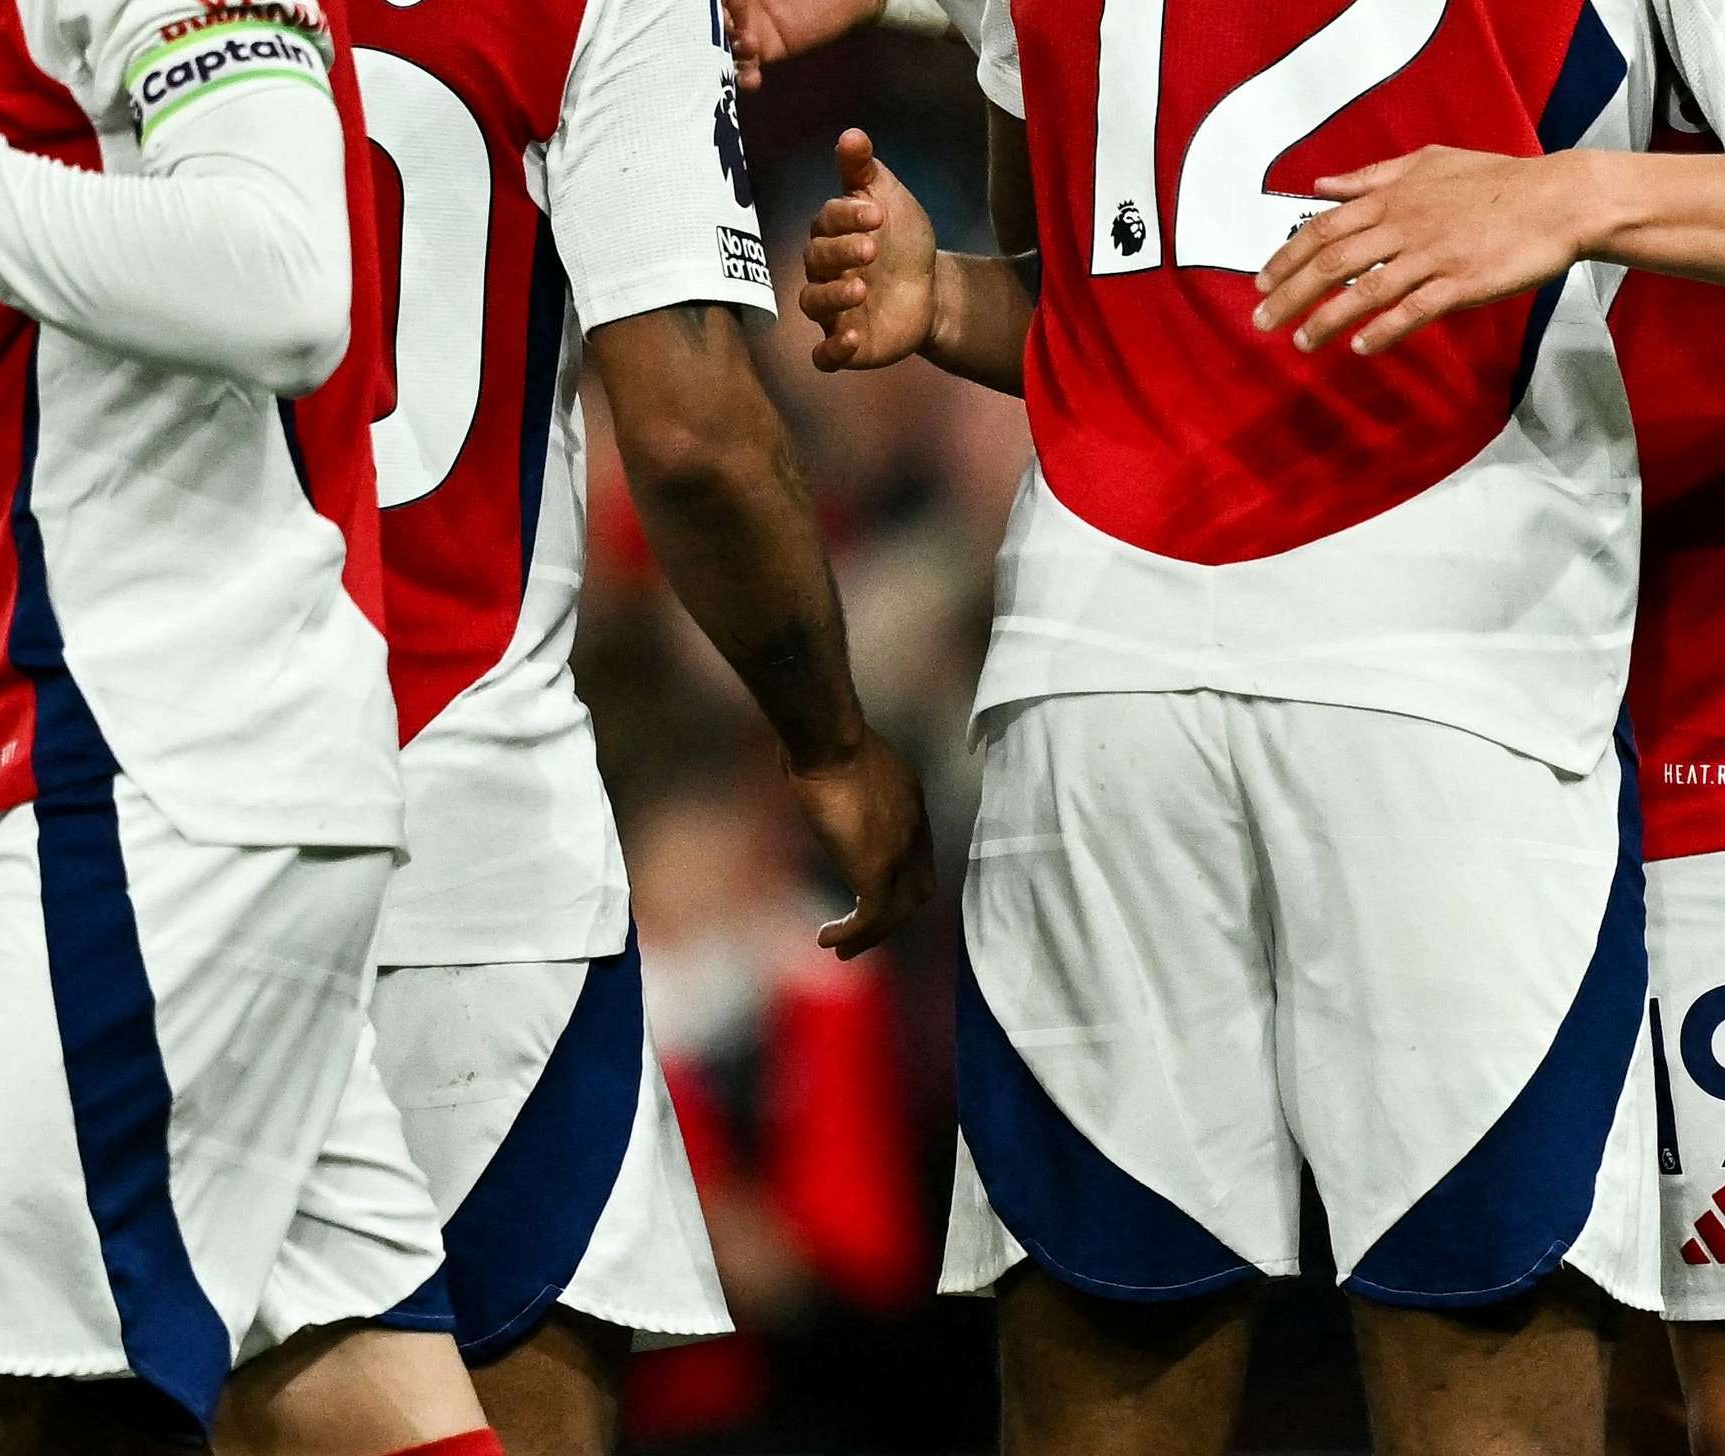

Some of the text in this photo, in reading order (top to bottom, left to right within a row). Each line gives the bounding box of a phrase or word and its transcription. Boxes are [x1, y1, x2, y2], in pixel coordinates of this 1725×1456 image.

[142, 33, 314, 105] Captain
[717, 227, 767, 267] No roo
[722, 251, 746, 279] for
